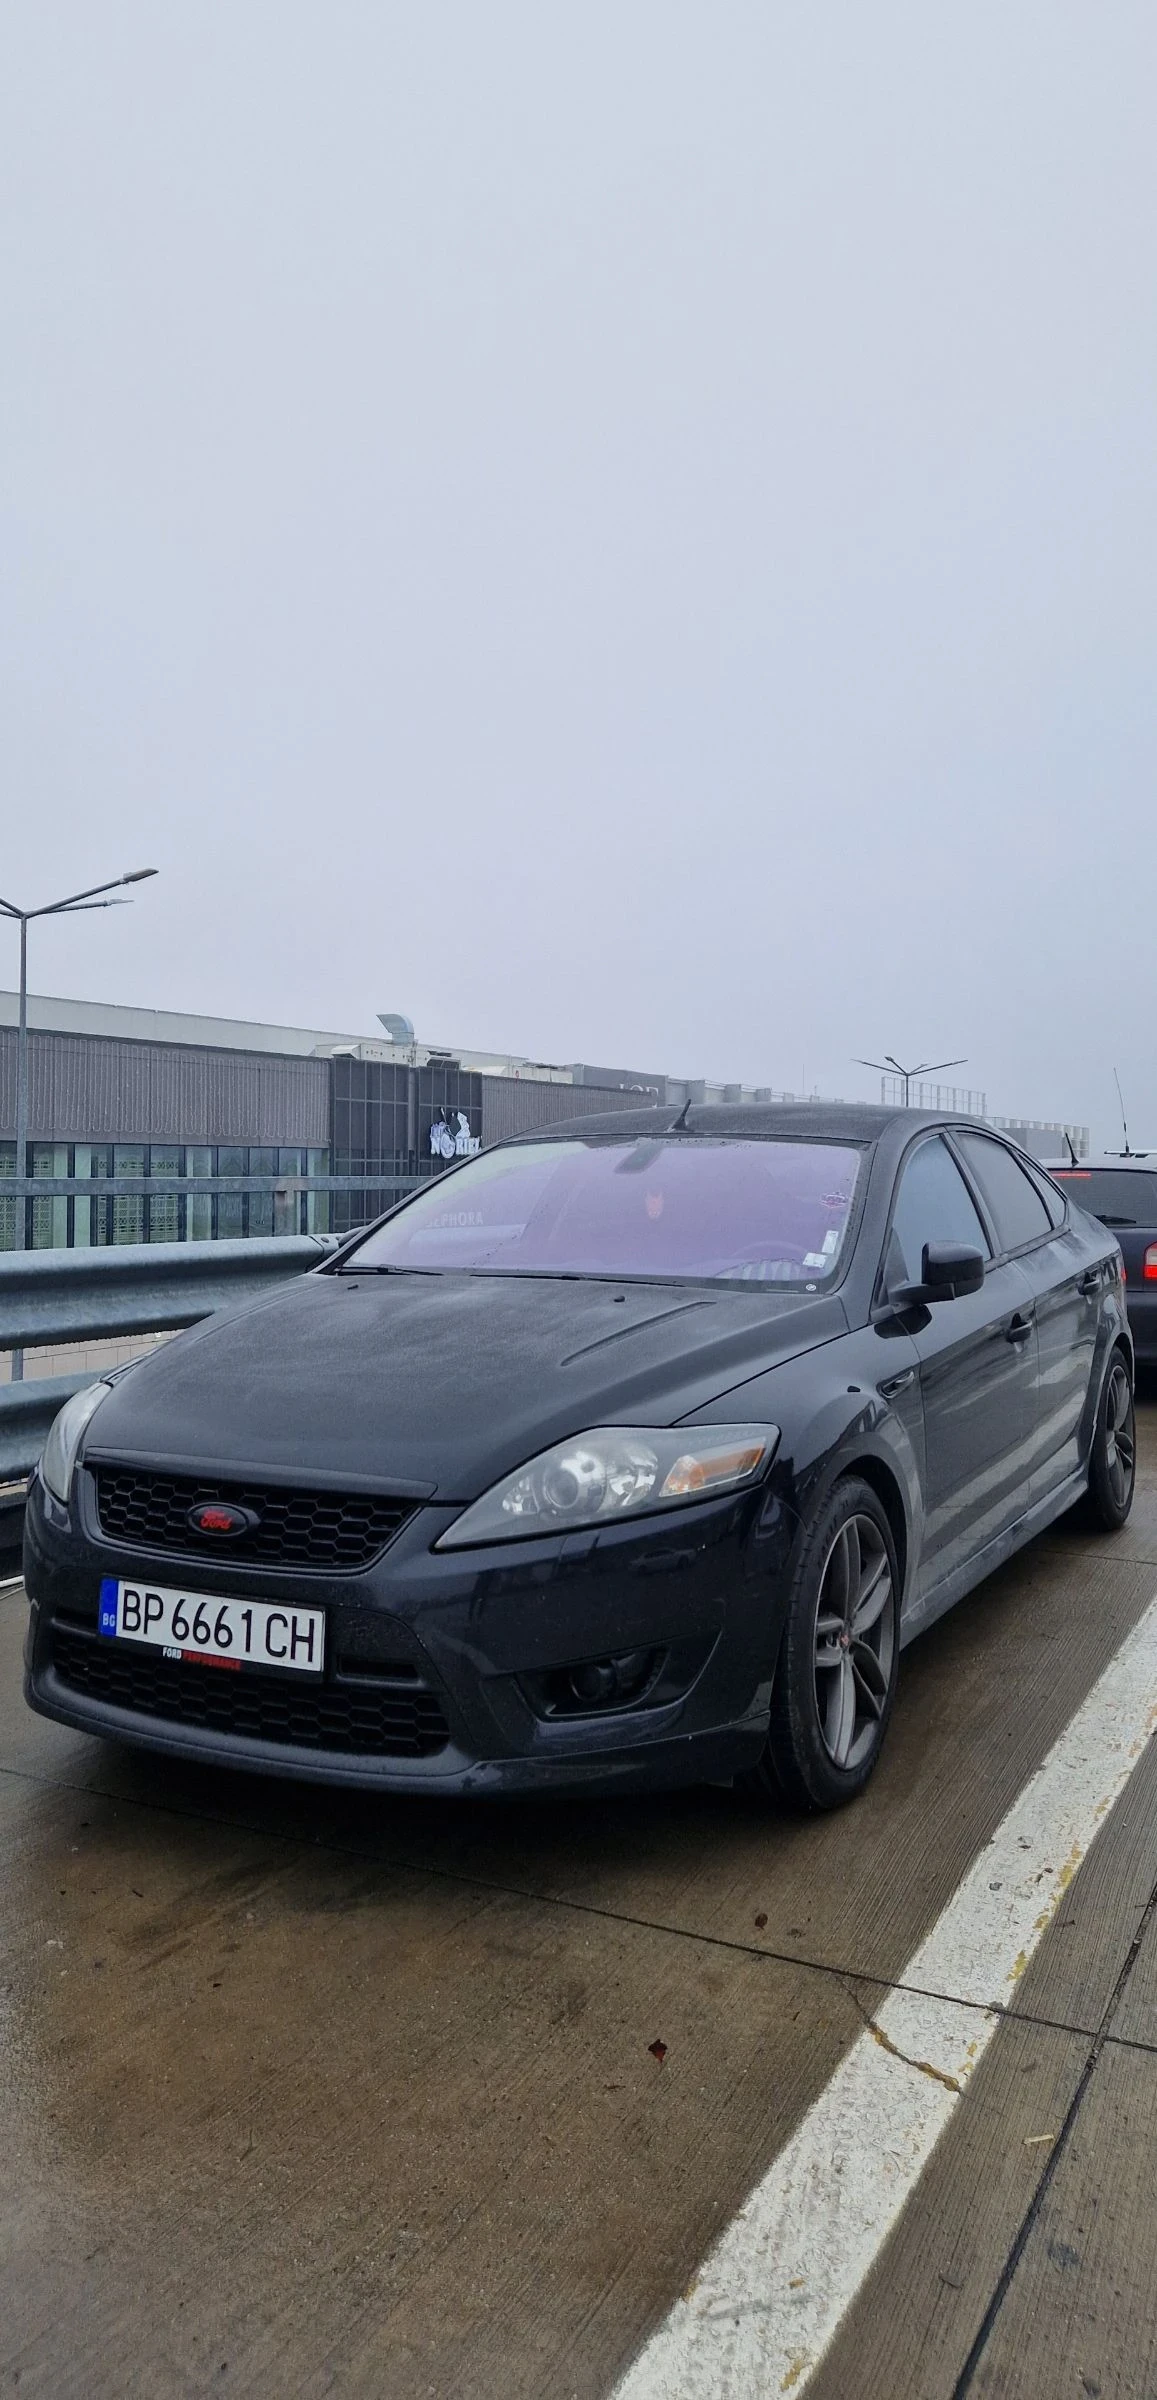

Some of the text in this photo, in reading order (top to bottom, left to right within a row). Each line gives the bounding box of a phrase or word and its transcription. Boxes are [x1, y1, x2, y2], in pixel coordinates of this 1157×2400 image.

[200, 1511, 232, 1531] Ford
[102, 1613, 116, 1627] BG
[122, 1589, 315, 1663] BP 6661 CH
[162, 1646, 182, 1660] FORD
